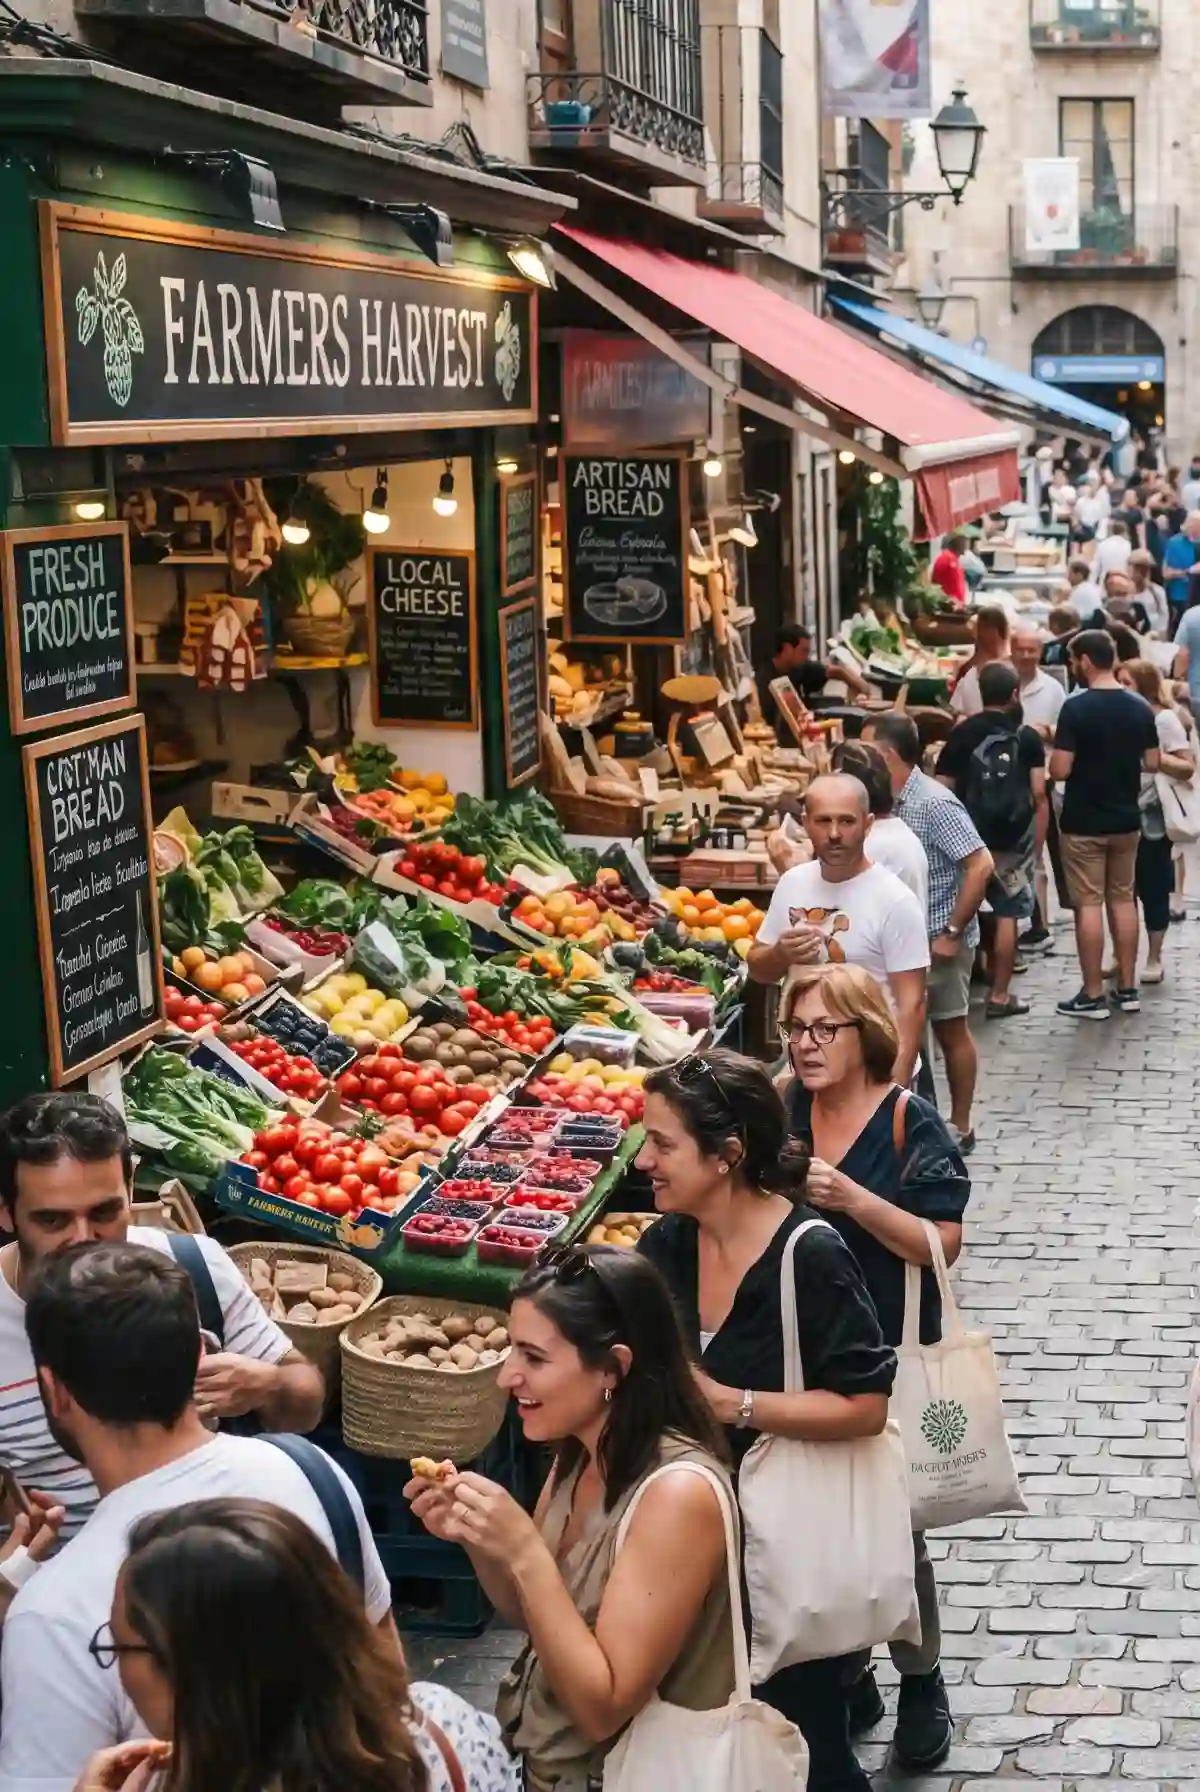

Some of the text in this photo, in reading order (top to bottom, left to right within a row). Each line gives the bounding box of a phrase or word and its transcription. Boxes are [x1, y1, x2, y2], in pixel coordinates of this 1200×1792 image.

[160, 275, 350, 388] FARMERS
[360, 299, 487, 388] HARVEST
[573, 461, 670, 489] ARTISAN
[585, 488, 664, 516] BREAD
[28, 541, 106, 597] FRESH
[387, 558, 461, 586] LOCAL
[22, 590, 120, 653] PRODUCE
[380, 586, 464, 617] CHEESE
[51, 780, 125, 843] BREAD
